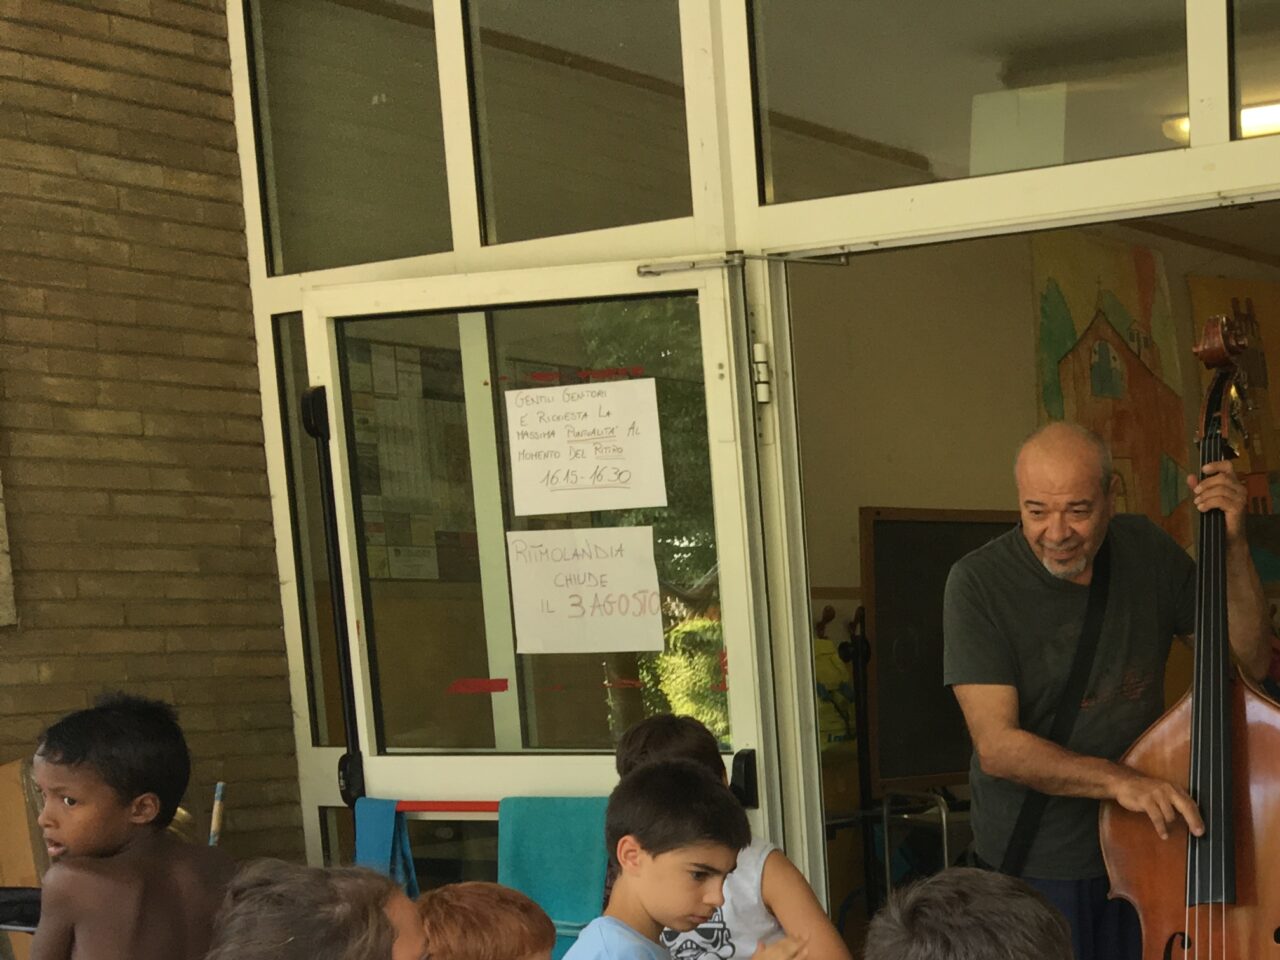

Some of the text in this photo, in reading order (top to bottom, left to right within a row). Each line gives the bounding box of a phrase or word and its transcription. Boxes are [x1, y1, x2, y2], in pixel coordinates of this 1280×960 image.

[518, 449, 560, 462] MOMENTO
[568, 445, 586, 461] DEL
[553, 572, 609, 588] CHIUDE
[541, 589, 661, 619] IL 3 AGOSTO
